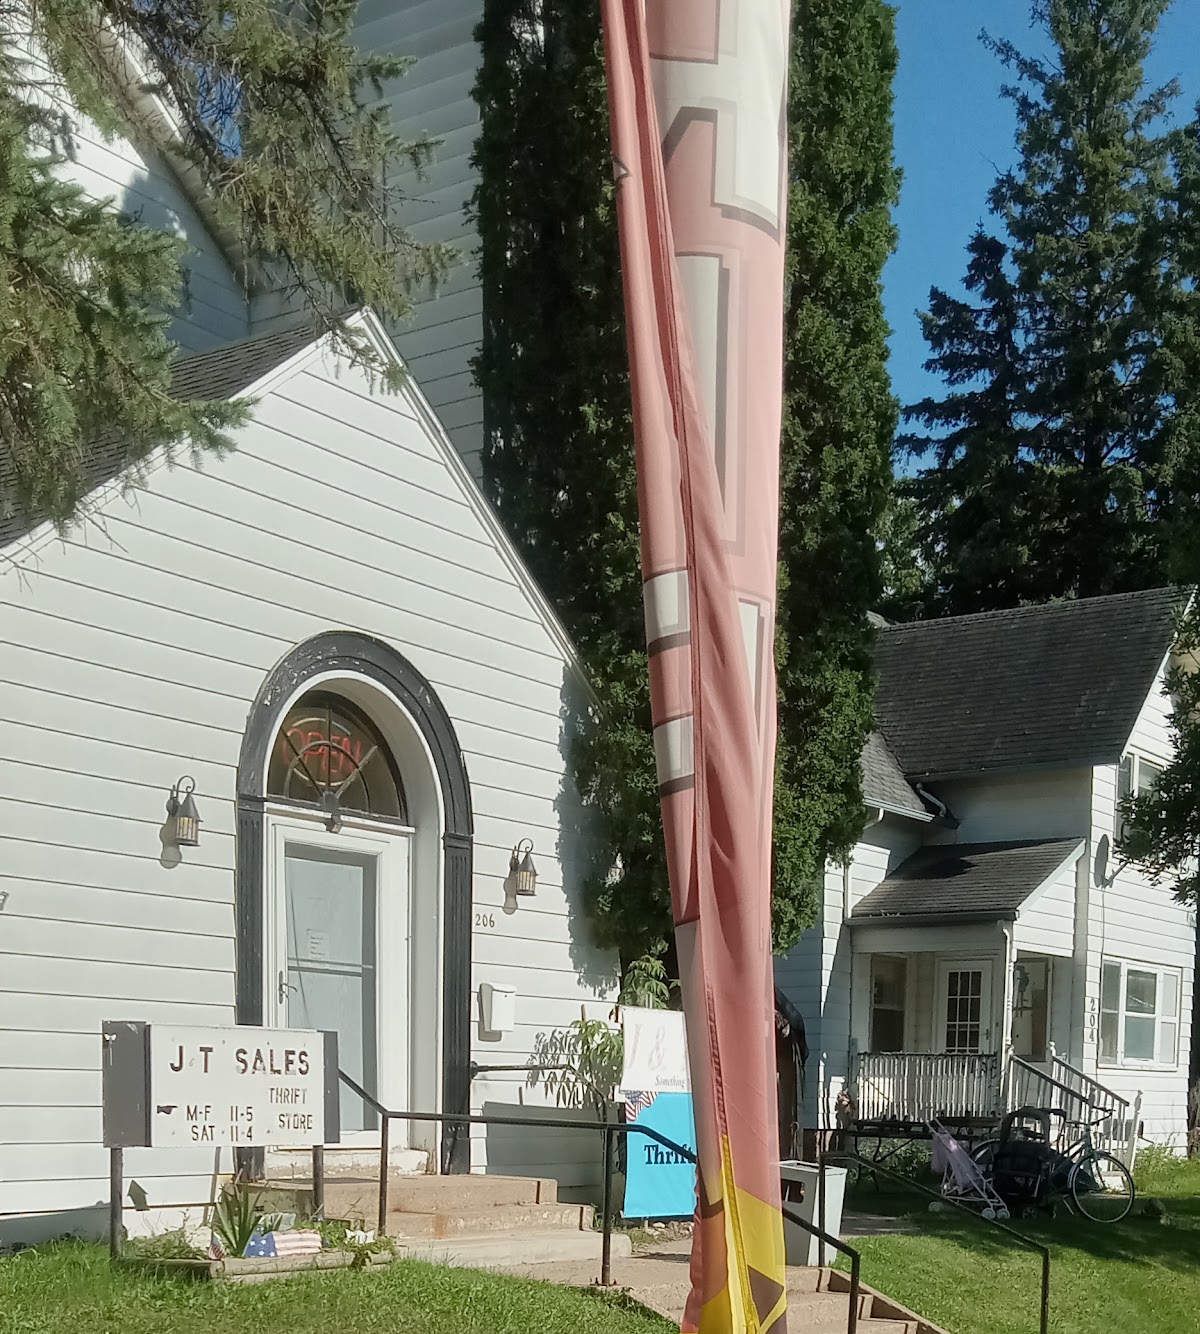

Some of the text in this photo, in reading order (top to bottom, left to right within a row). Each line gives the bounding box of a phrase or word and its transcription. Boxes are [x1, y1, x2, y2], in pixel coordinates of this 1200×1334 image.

[282, 727, 362, 774] OPEN
[475, 913, 495, 928] 206
[1088, 997, 1096, 1042] 204
[170, 1045, 310, 1076] J T SALES
[654, 1074, 685, 1088] Something
[269, 1087, 308, 1105] THRIFT
[186, 1104, 254, 1122] M-F 11-5
[278, 1113, 313, 1130] STORE
[191, 1124, 254, 1142] SAT 11-4
